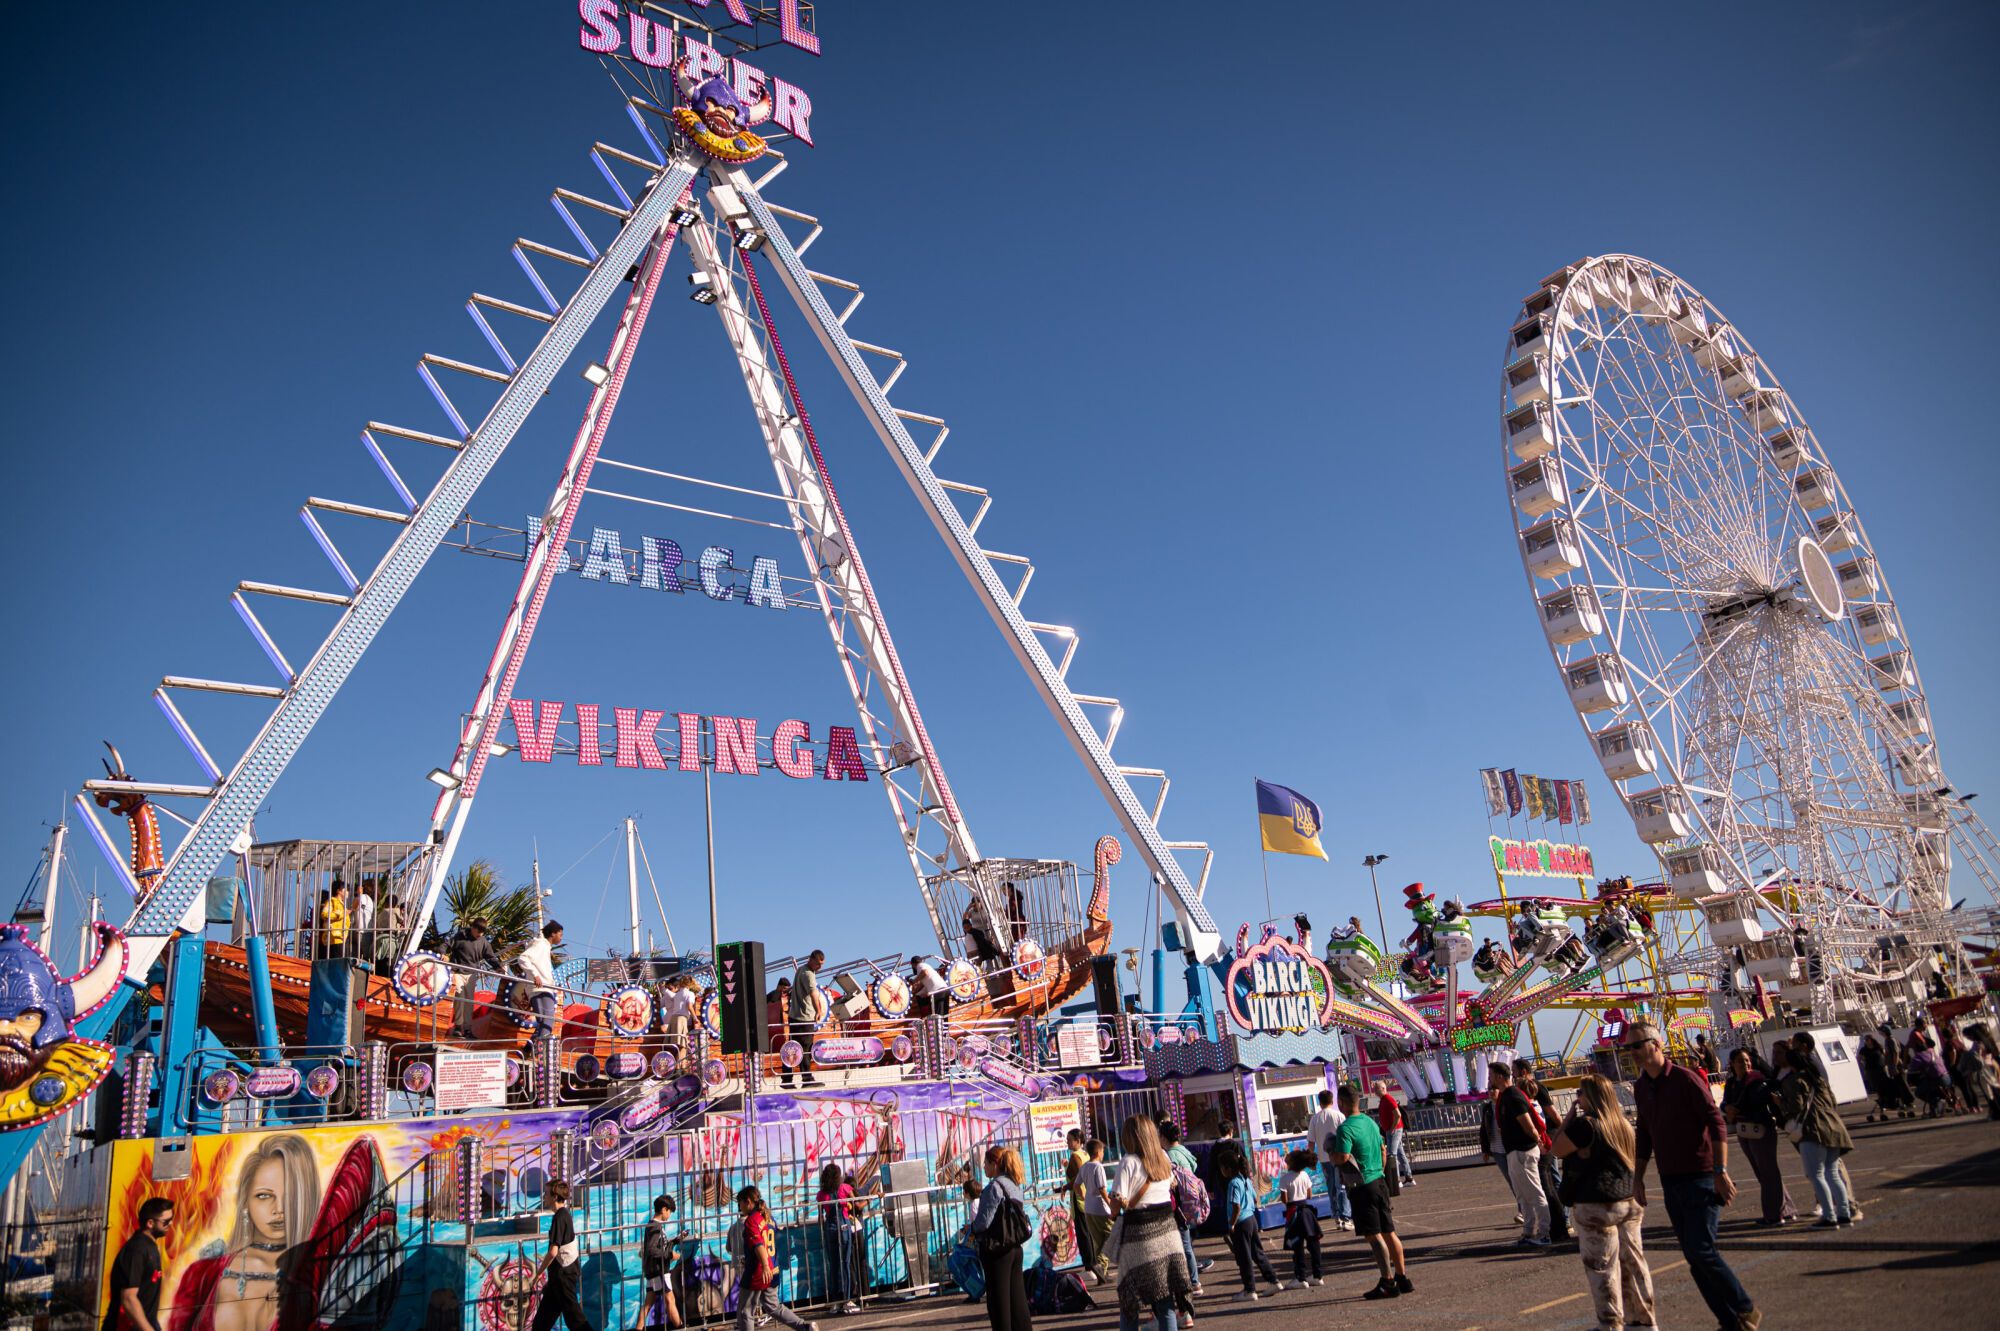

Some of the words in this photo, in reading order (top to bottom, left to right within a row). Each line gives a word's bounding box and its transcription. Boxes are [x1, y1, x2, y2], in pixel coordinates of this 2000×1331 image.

[578, 0, 815, 148] SUPER
[509, 699, 869, 782] VIKINGA
[1252, 958, 1312, 993] BARCA
[1246, 994, 1321, 1030] VIKINGA
